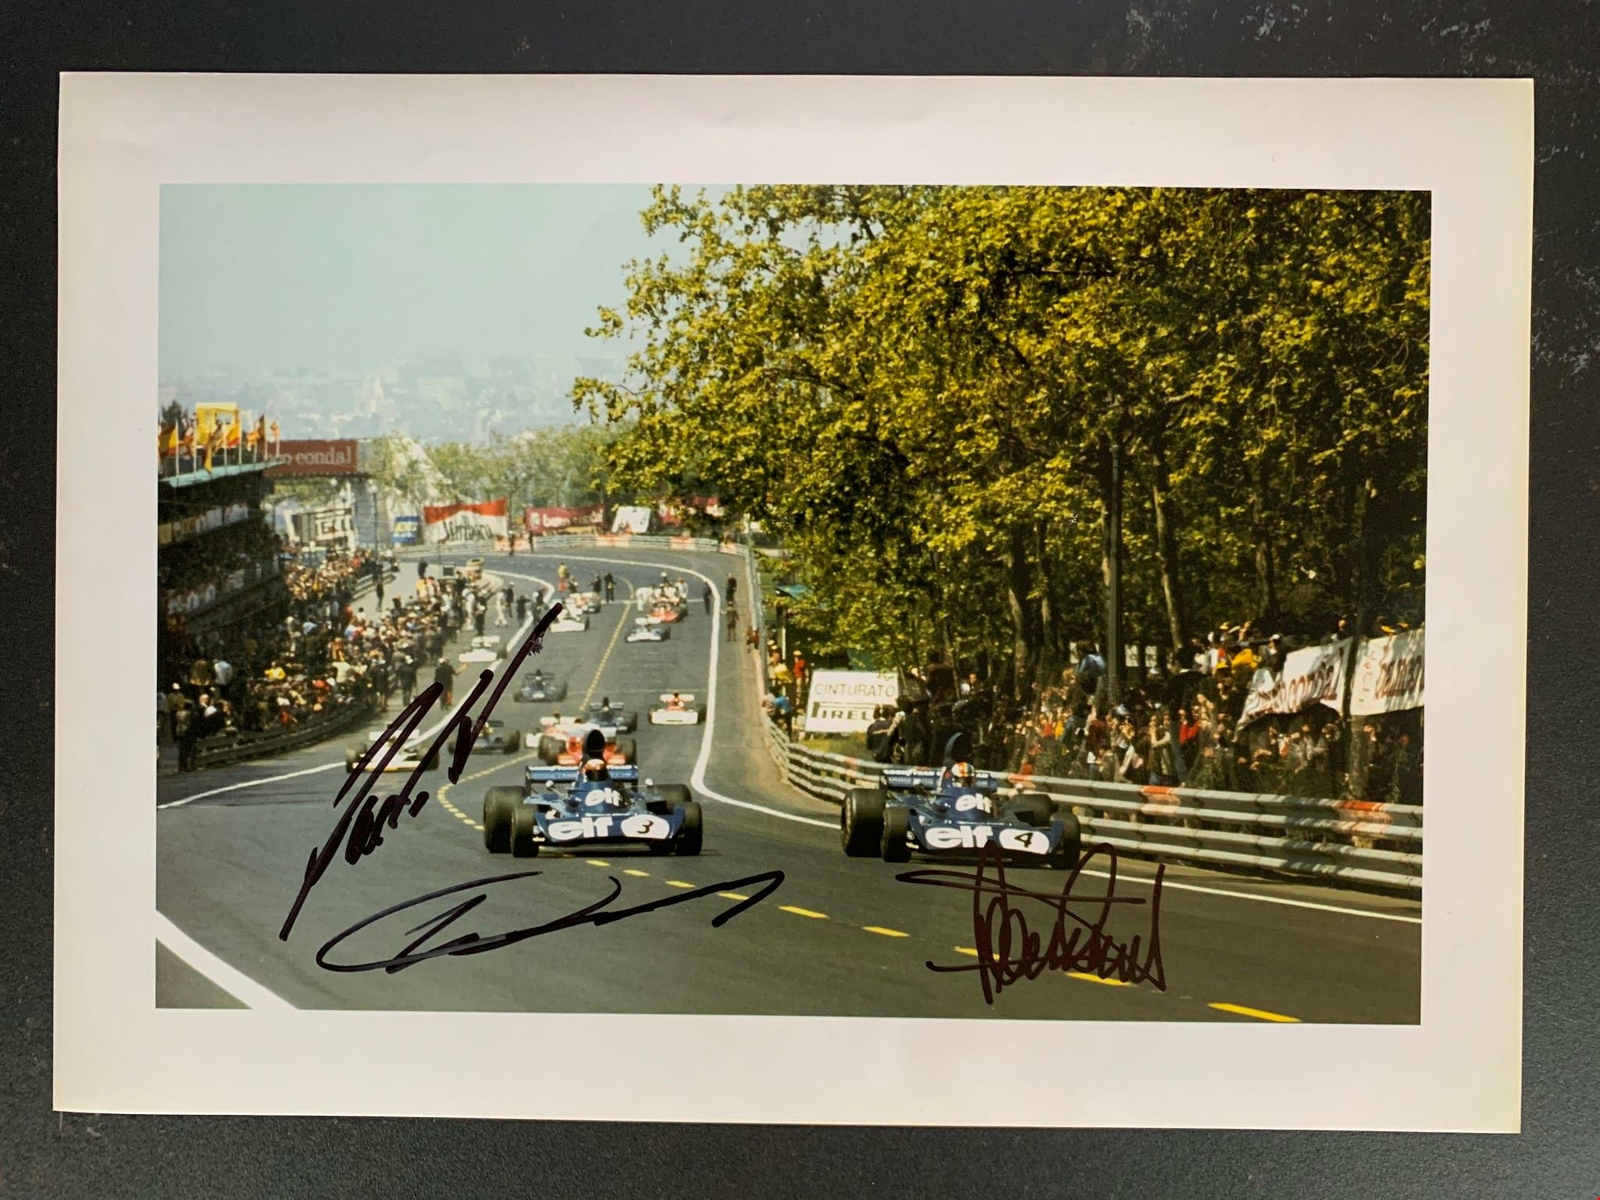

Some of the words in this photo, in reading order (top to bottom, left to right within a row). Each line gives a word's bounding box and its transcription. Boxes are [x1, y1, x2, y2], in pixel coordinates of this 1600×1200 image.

[813, 682, 896, 698] CINTURATO
[811, 701, 875, 721] PIREL
[585, 787, 621, 807] elf
[955, 794, 993, 814] elf
[548, 816, 614, 840] elf
[636, 819, 654, 835] 3
[925, 825, 994, 849] elf
[1014, 832, 1035, 849] 4
